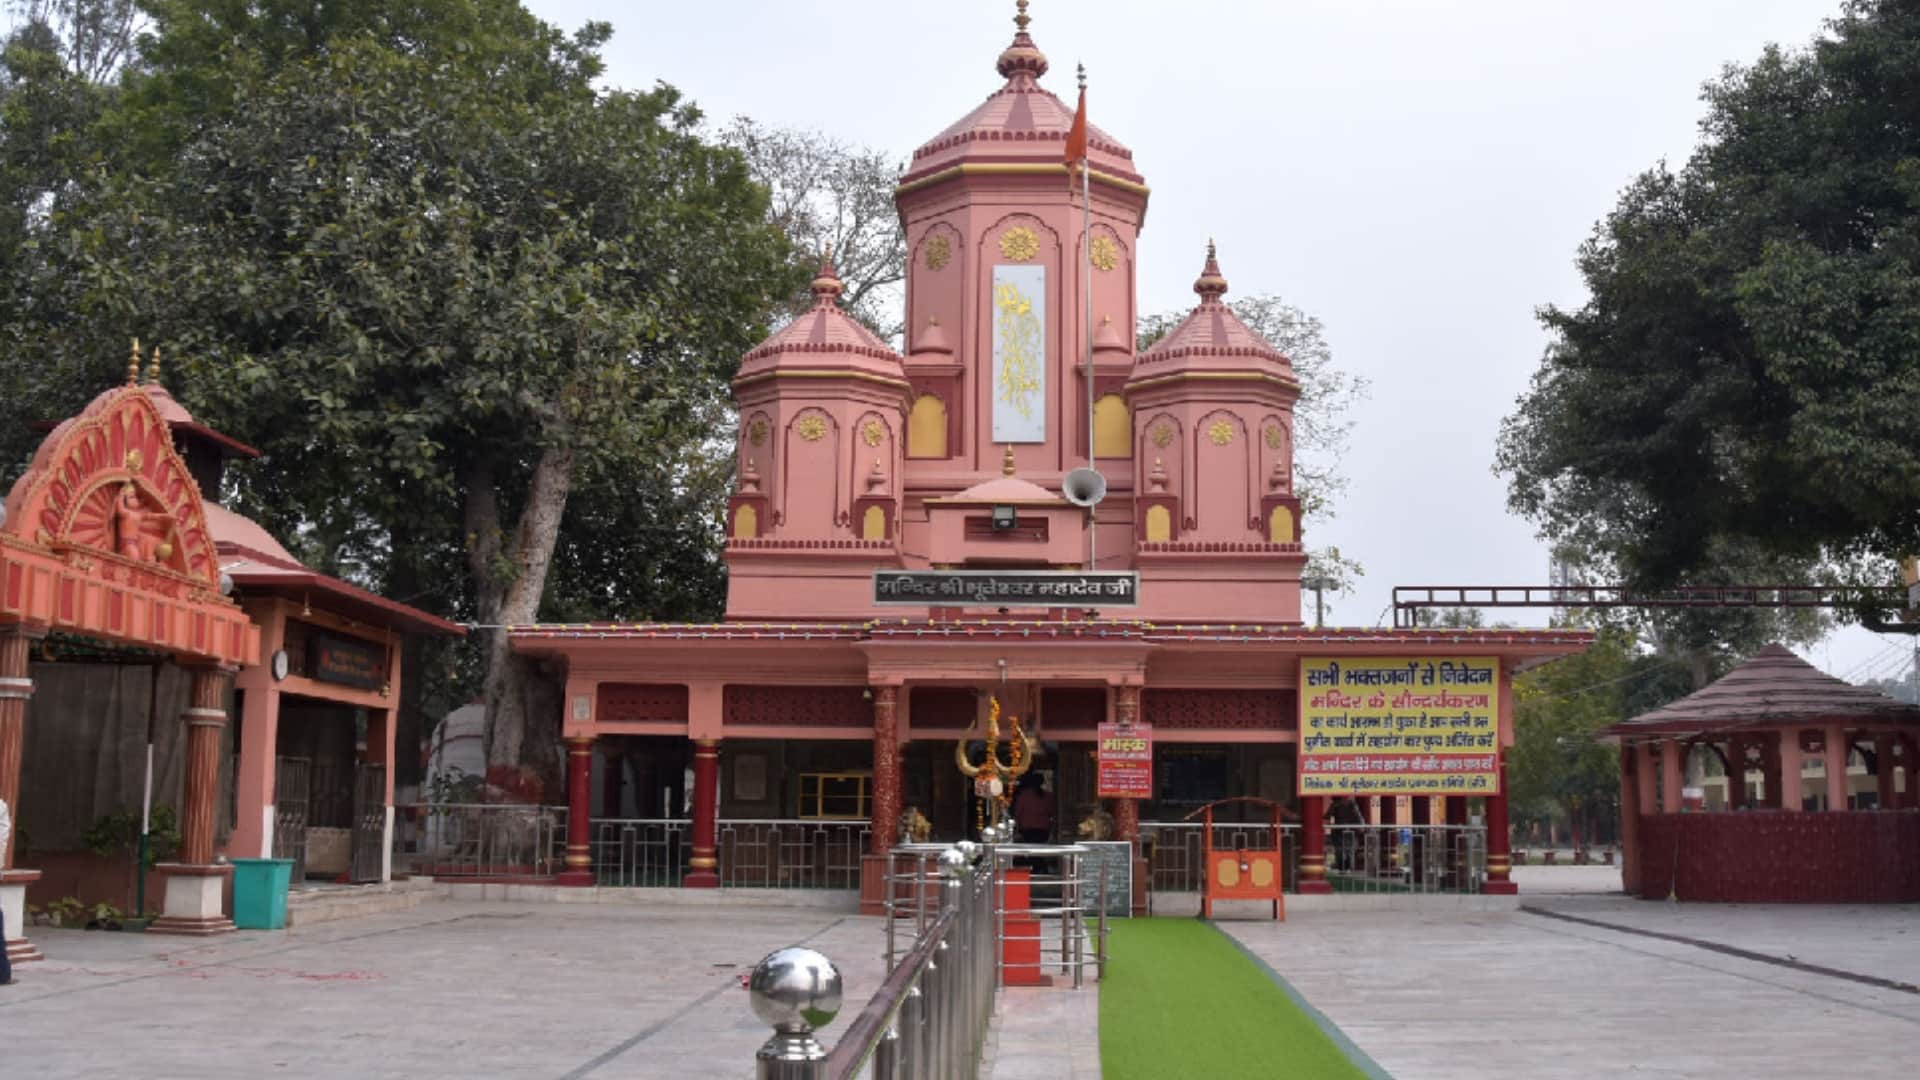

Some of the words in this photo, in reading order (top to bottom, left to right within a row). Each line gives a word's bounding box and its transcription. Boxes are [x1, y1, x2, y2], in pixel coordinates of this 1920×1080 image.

[940, 577, 964, 594] श्री
[966, 578, 1033, 601] भूतेश्वर
[1039, 578, 1101, 595] महादेव
[1104, 578, 1132, 595] जी
[1307, 662, 1340, 686] सभी
[1344, 662, 1418, 686] भक्तजनों
[1421, 663, 1435, 686] से
[1440, 662, 1492, 685] निवेदन
[1368, 690, 1385, 708] के
[1326, 711, 1347, 728] कार्य
[1396, 716, 1417, 732] चुका
[1104, 738, 1148, 751] मास्क
[1356, 731, 1367, 747] में
[1477, 731, 1495, 747] करें
